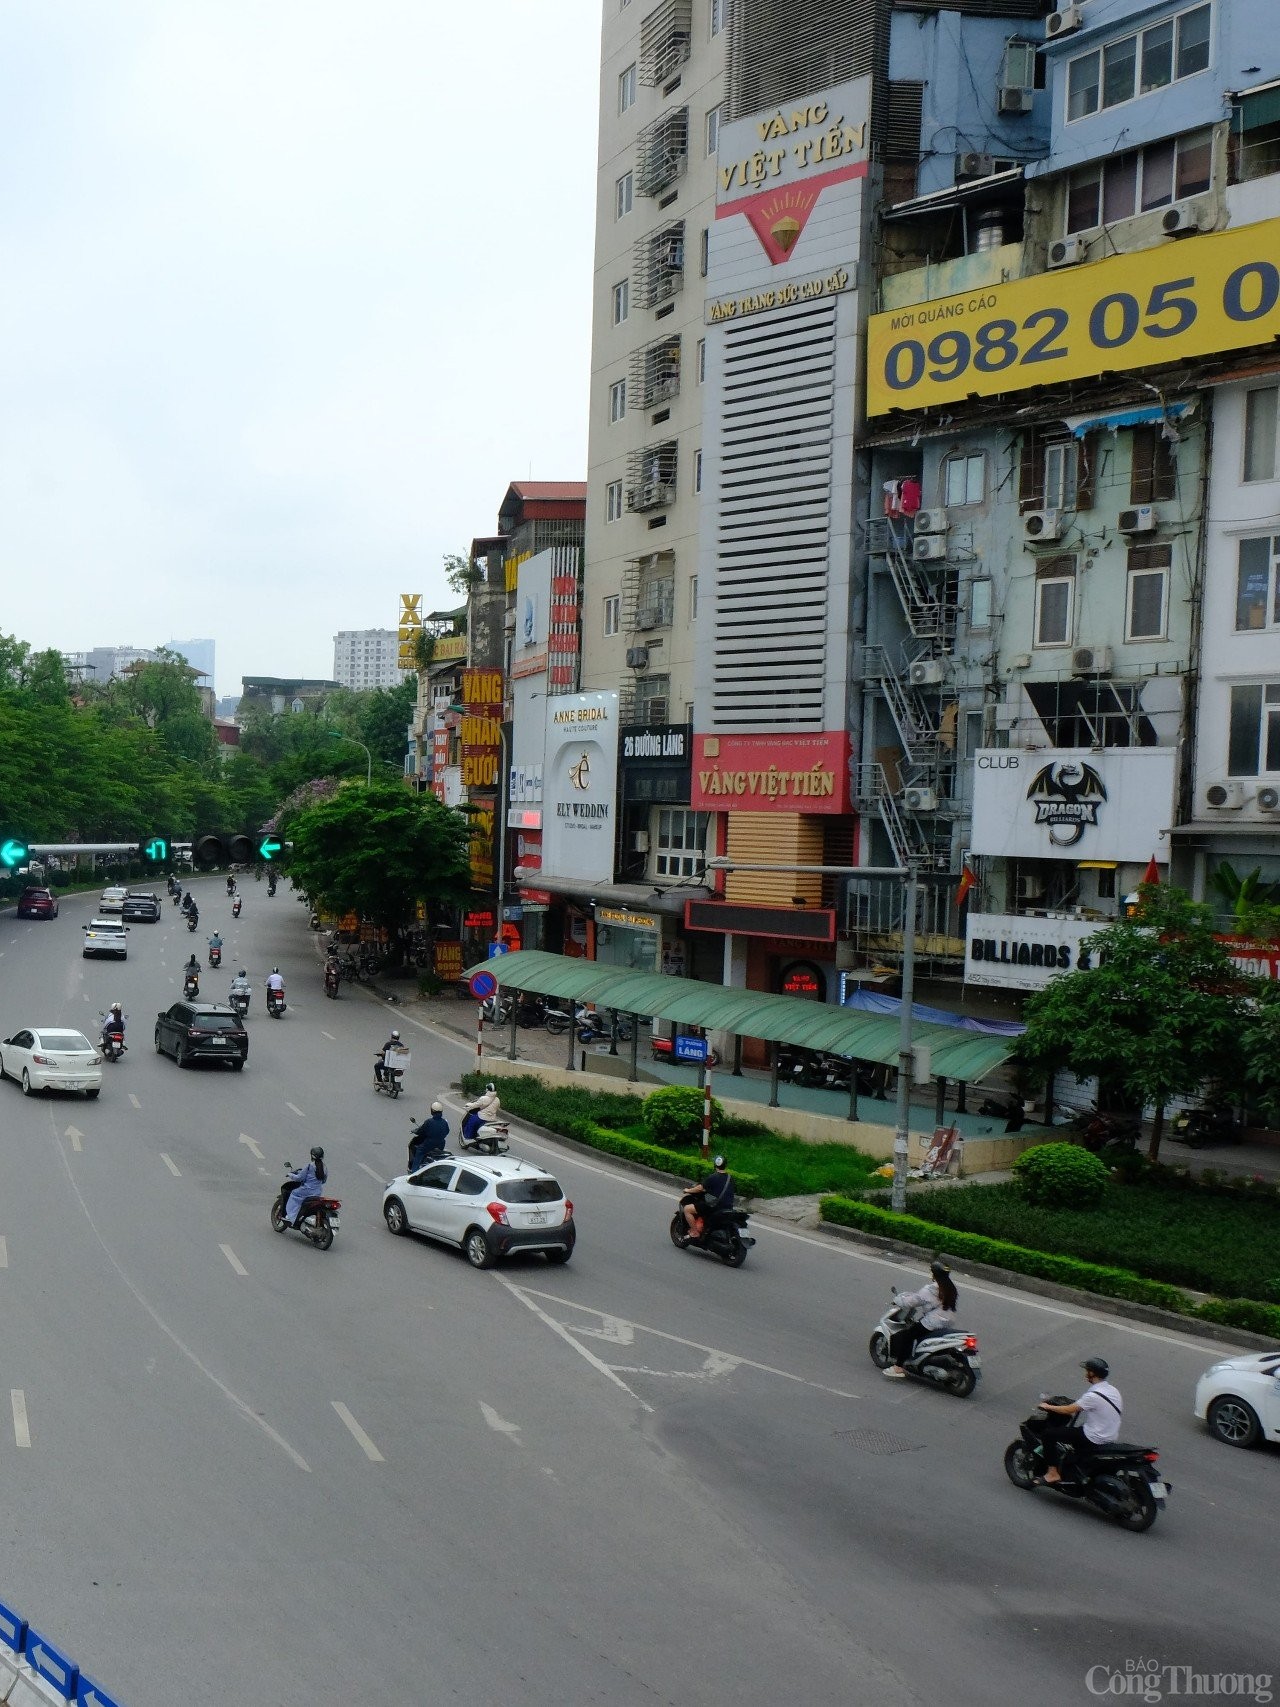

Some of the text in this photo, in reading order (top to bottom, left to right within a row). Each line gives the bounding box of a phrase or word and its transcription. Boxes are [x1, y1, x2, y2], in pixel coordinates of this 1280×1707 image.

[756, 102, 829, 141] VÀNG
[719, 115, 866, 191] VIỆT TIẾN
[710, 268, 848, 320] VÀNG TRANG SÚC CAO CẤP
[884, 261, 1280, 390] 0982 05 0
[890, 294, 998, 331] MỜI QUẢNG CÁO
[463, 670, 501, 703] VÀNG
[554, 708, 608, 723] ANNE BRIDAL
[624, 729, 684, 756] 26 ĐƯỜNG LÁNG
[978, 756, 1019, 769] CLUB
[699, 765, 747, 795] VÀNG
[747, 764, 792, 802] VIỆT
[792, 760, 834, 796] TIẾN
[557, 802, 571, 817] ELY
[1038, 802, 1095, 822] DRAGON
[972, 938, 1070, 968] BILLIARDS
[678, 1046, 703, 1058] LÁNG
